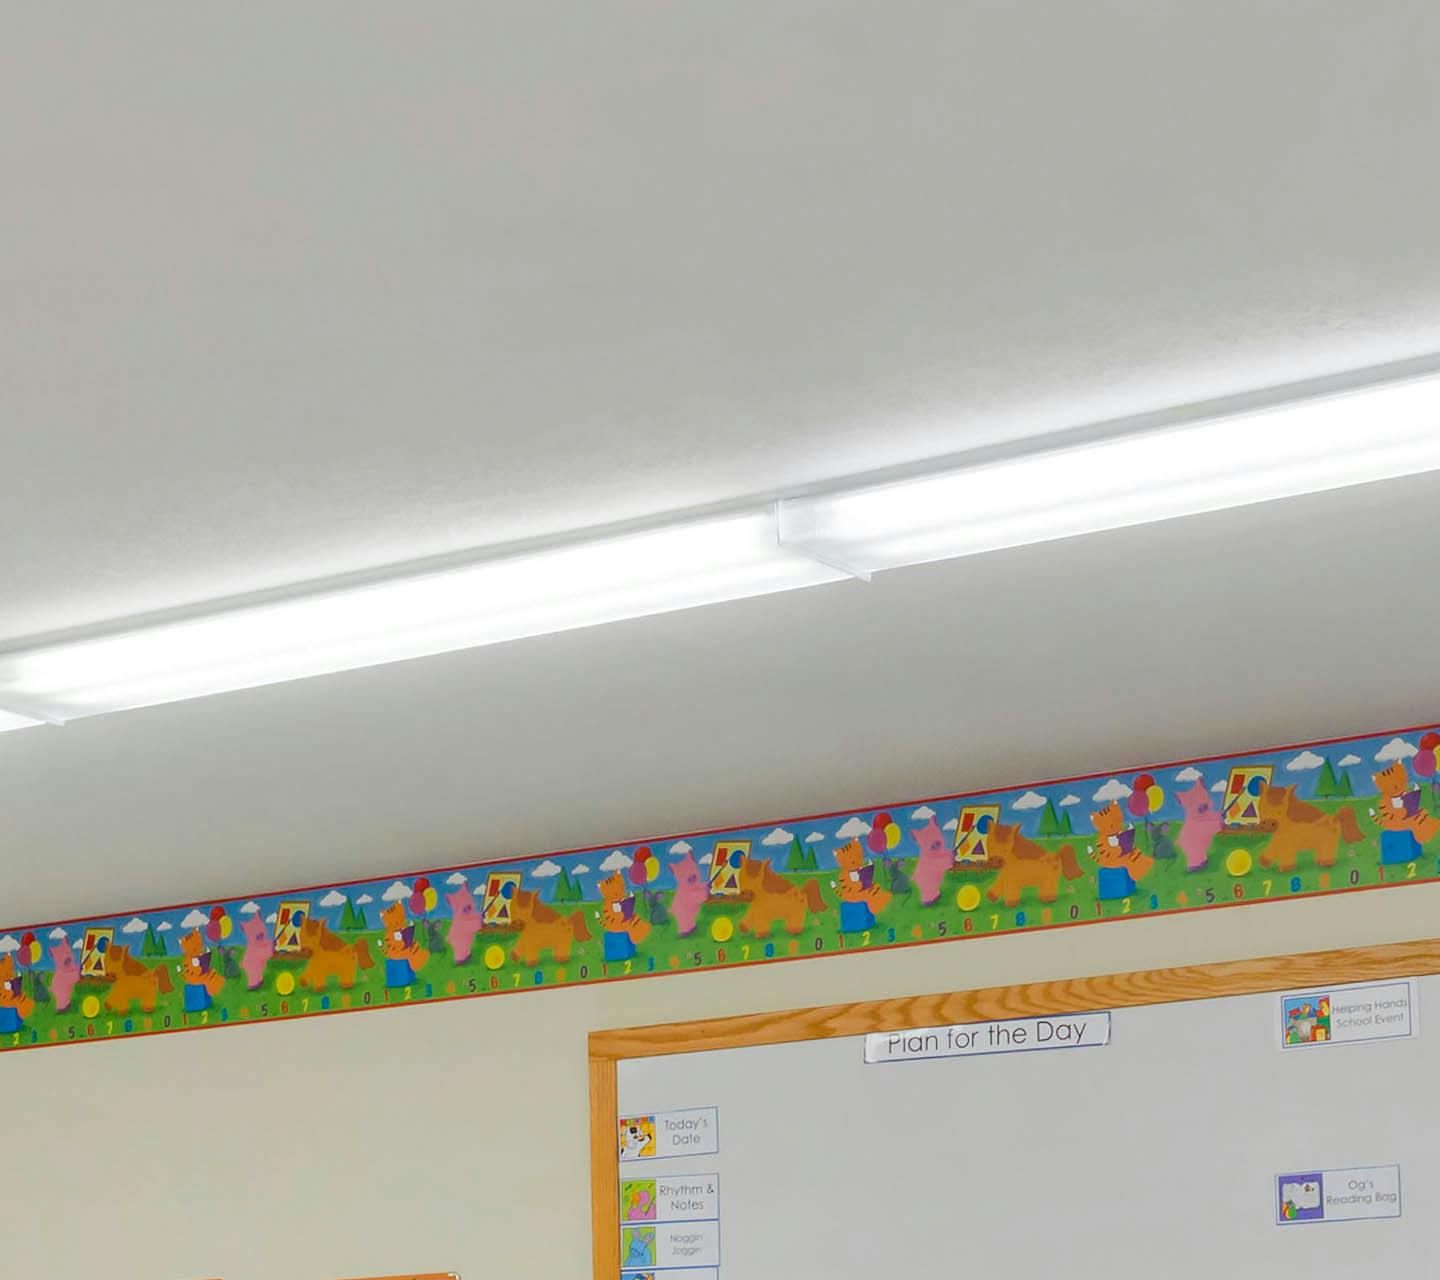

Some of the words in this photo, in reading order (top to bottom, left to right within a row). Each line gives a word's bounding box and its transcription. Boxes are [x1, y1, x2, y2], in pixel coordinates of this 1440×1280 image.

[889, 1033, 938, 1053] Plan
[948, 1028, 978, 1048] for
[989, 1025, 1027, 1045] the
[1037, 1021, 1086, 1044] Day
[665, 1119, 707, 1131] Today's
[673, 1135, 700, 1145] Date
[659, 1184, 703, 1197] Rhythm
[706, 1184, 714, 1194] &
[671, 1200, 704, 1211] Notes
